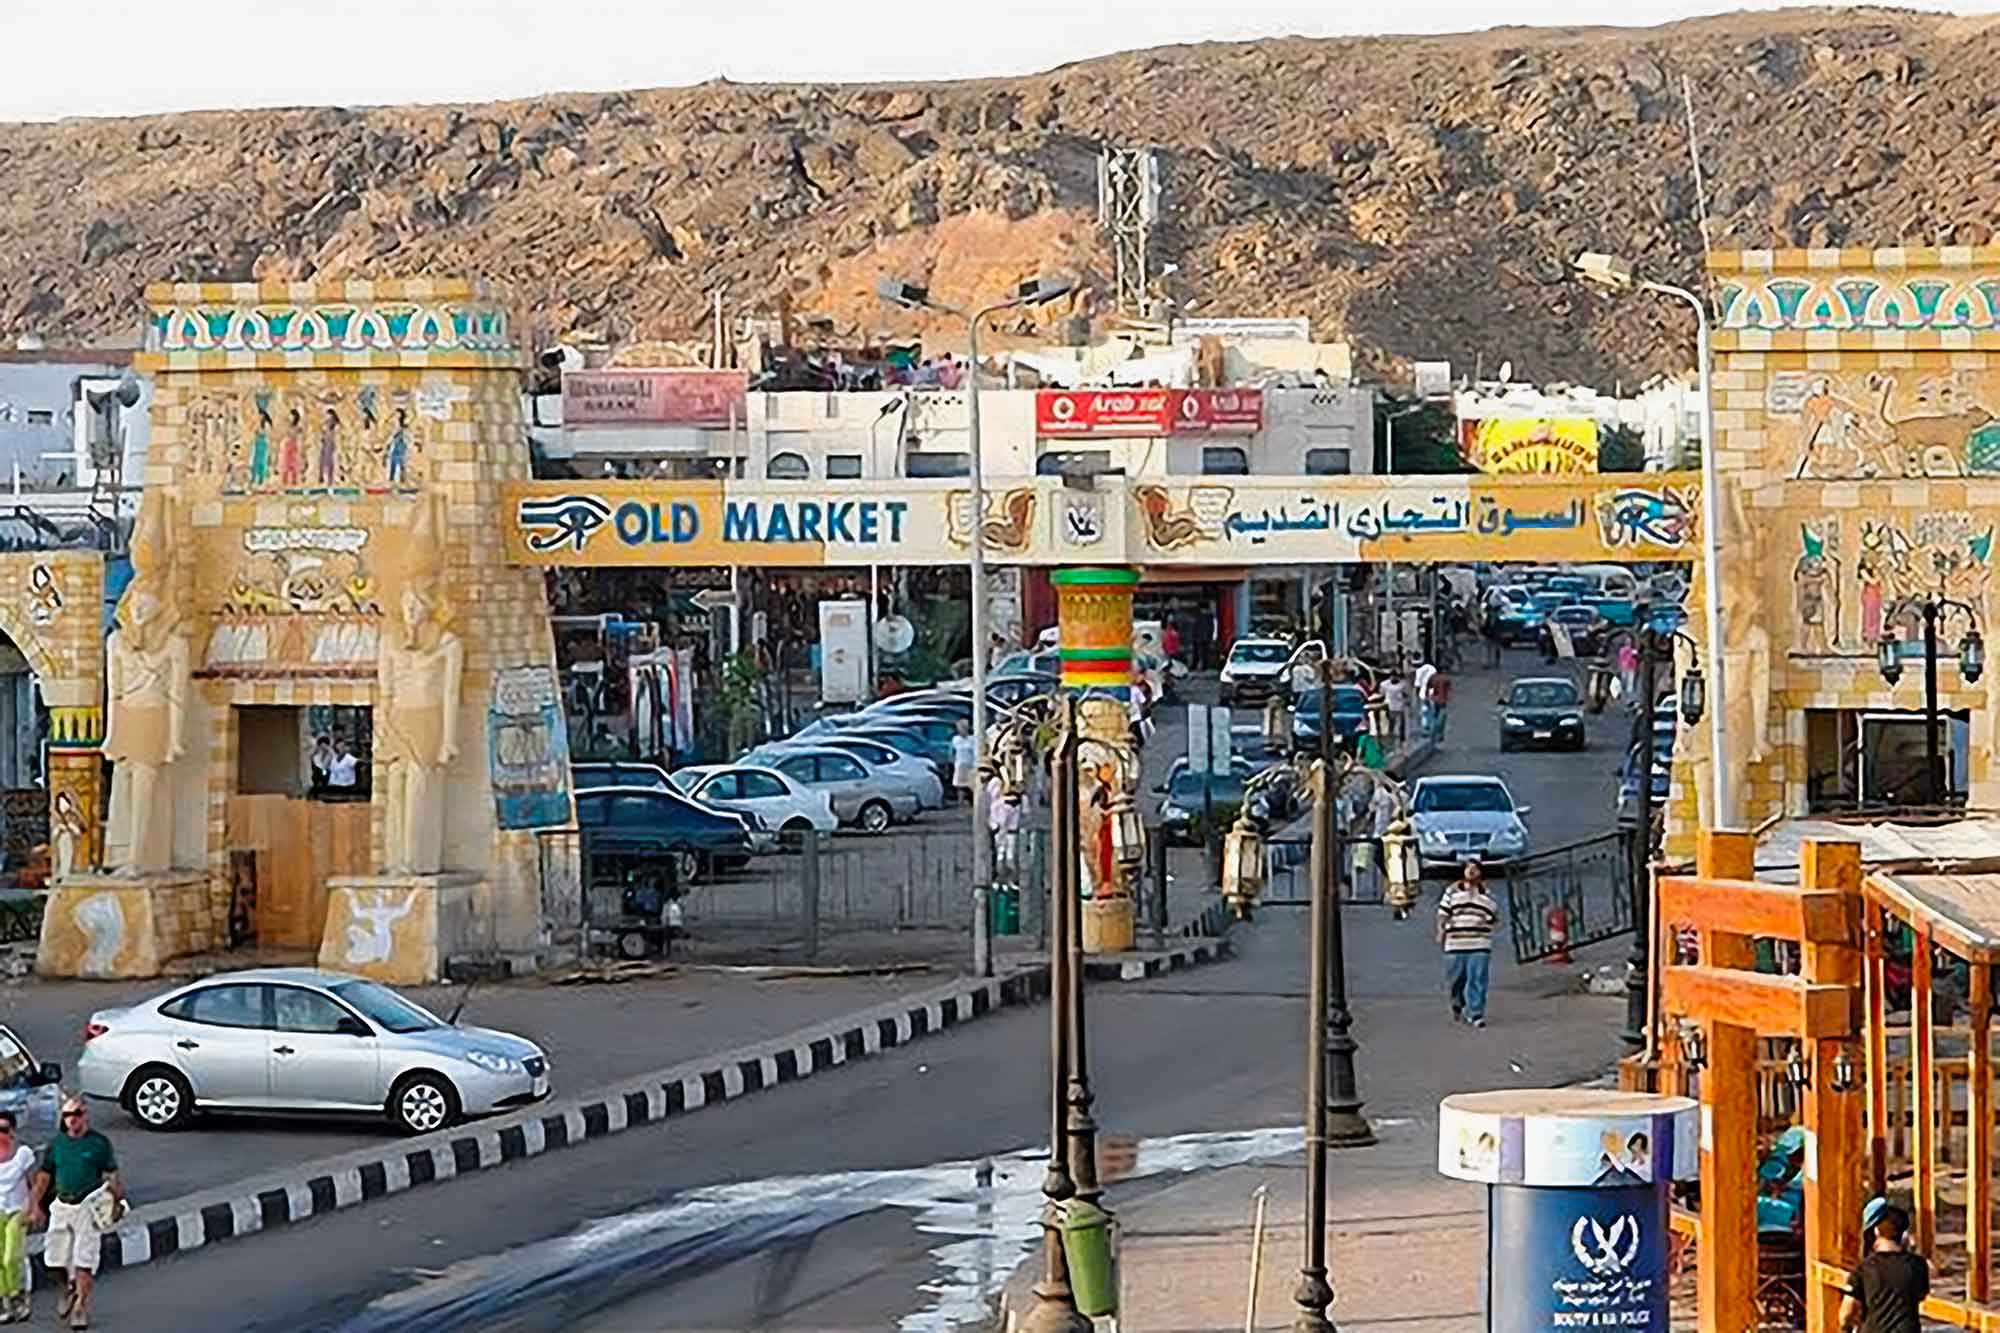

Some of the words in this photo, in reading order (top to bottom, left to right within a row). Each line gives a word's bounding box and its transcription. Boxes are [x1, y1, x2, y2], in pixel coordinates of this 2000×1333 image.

[614, 501, 699, 546] OLD
[722, 502, 907, 542] MARKET
[1224, 497, 1340, 543] القديم
[1475, 497, 1585, 537] السوق
